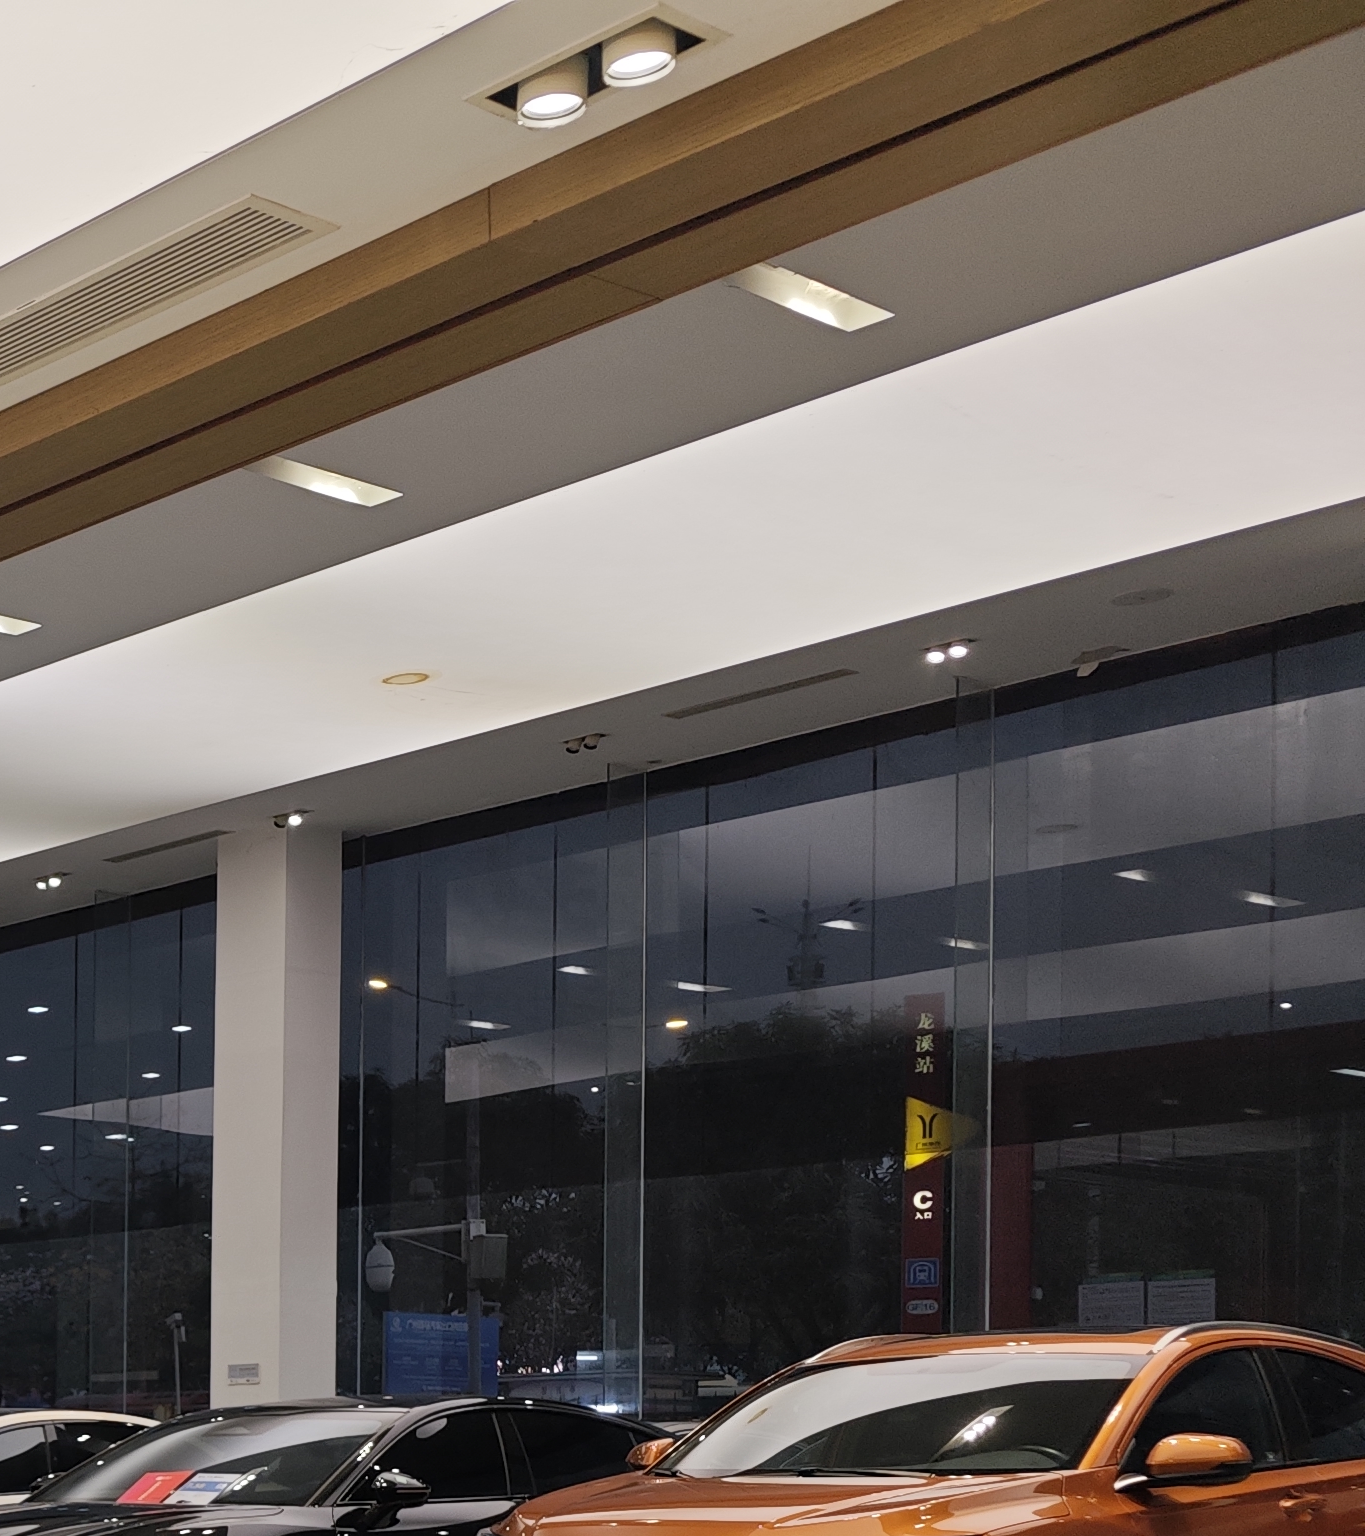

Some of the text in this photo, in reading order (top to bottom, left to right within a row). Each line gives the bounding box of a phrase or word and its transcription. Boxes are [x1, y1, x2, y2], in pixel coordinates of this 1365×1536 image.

[914, 1012, 935, 1074] 龙溪站
[912, 1190, 934, 1209] C
[914, 1211, 933, 1221] 入口
